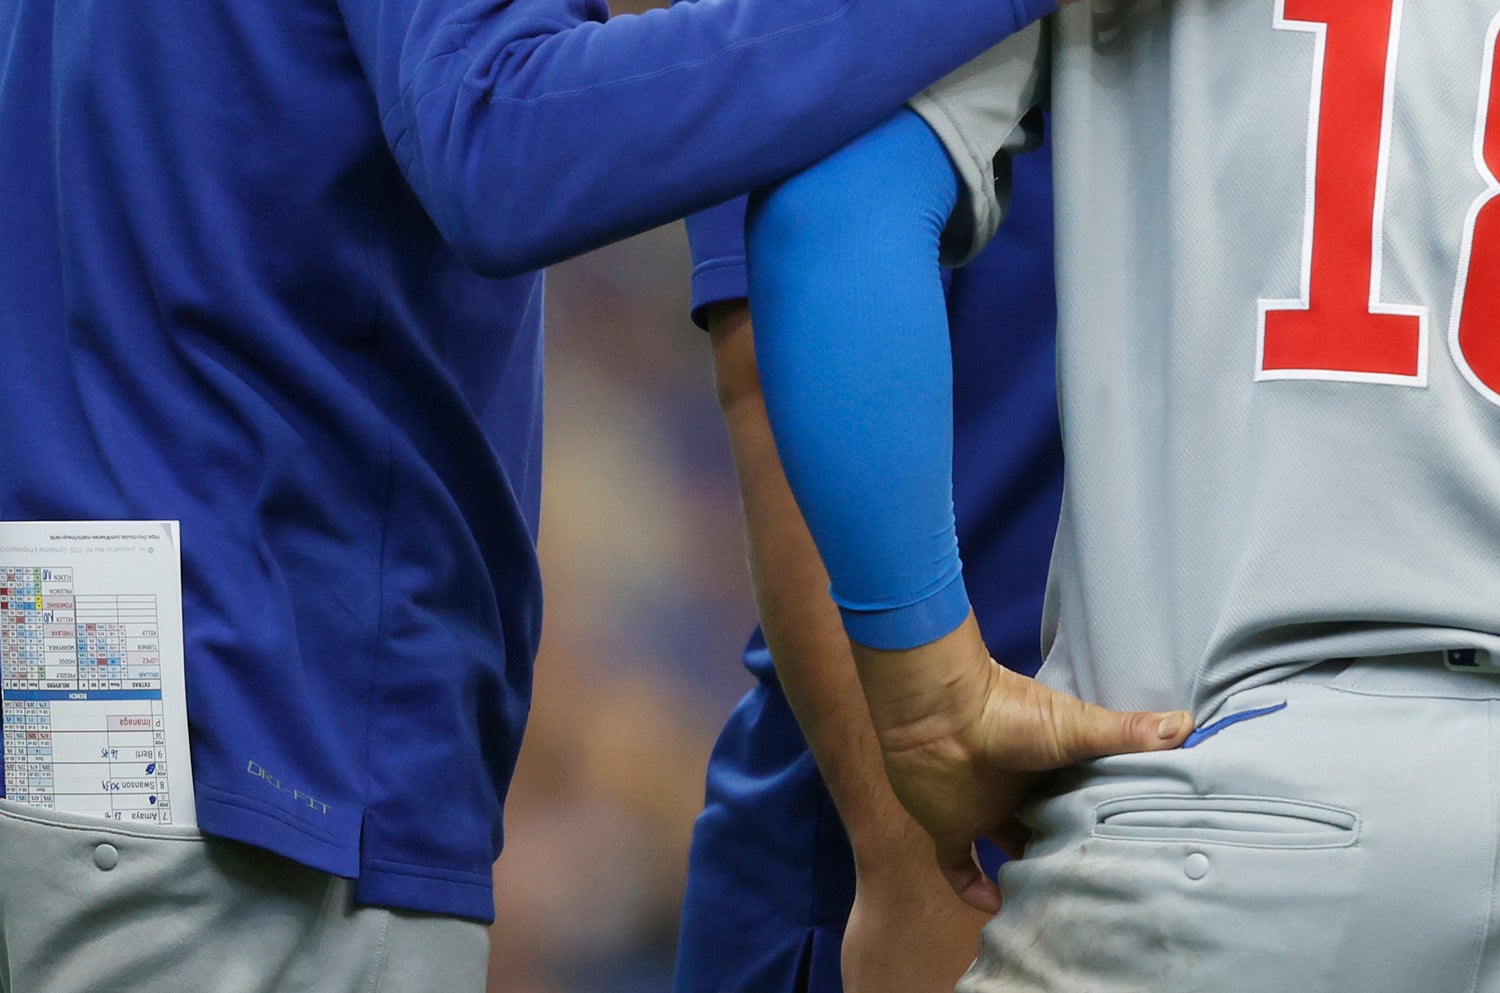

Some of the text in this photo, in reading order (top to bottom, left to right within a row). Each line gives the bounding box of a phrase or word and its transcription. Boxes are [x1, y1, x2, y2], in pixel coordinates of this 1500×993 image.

[120, 718, 160, 727] P Imanaga
[136, 750, 152, 759] Berti
[132, 811, 168, 820] 7 Amaya
